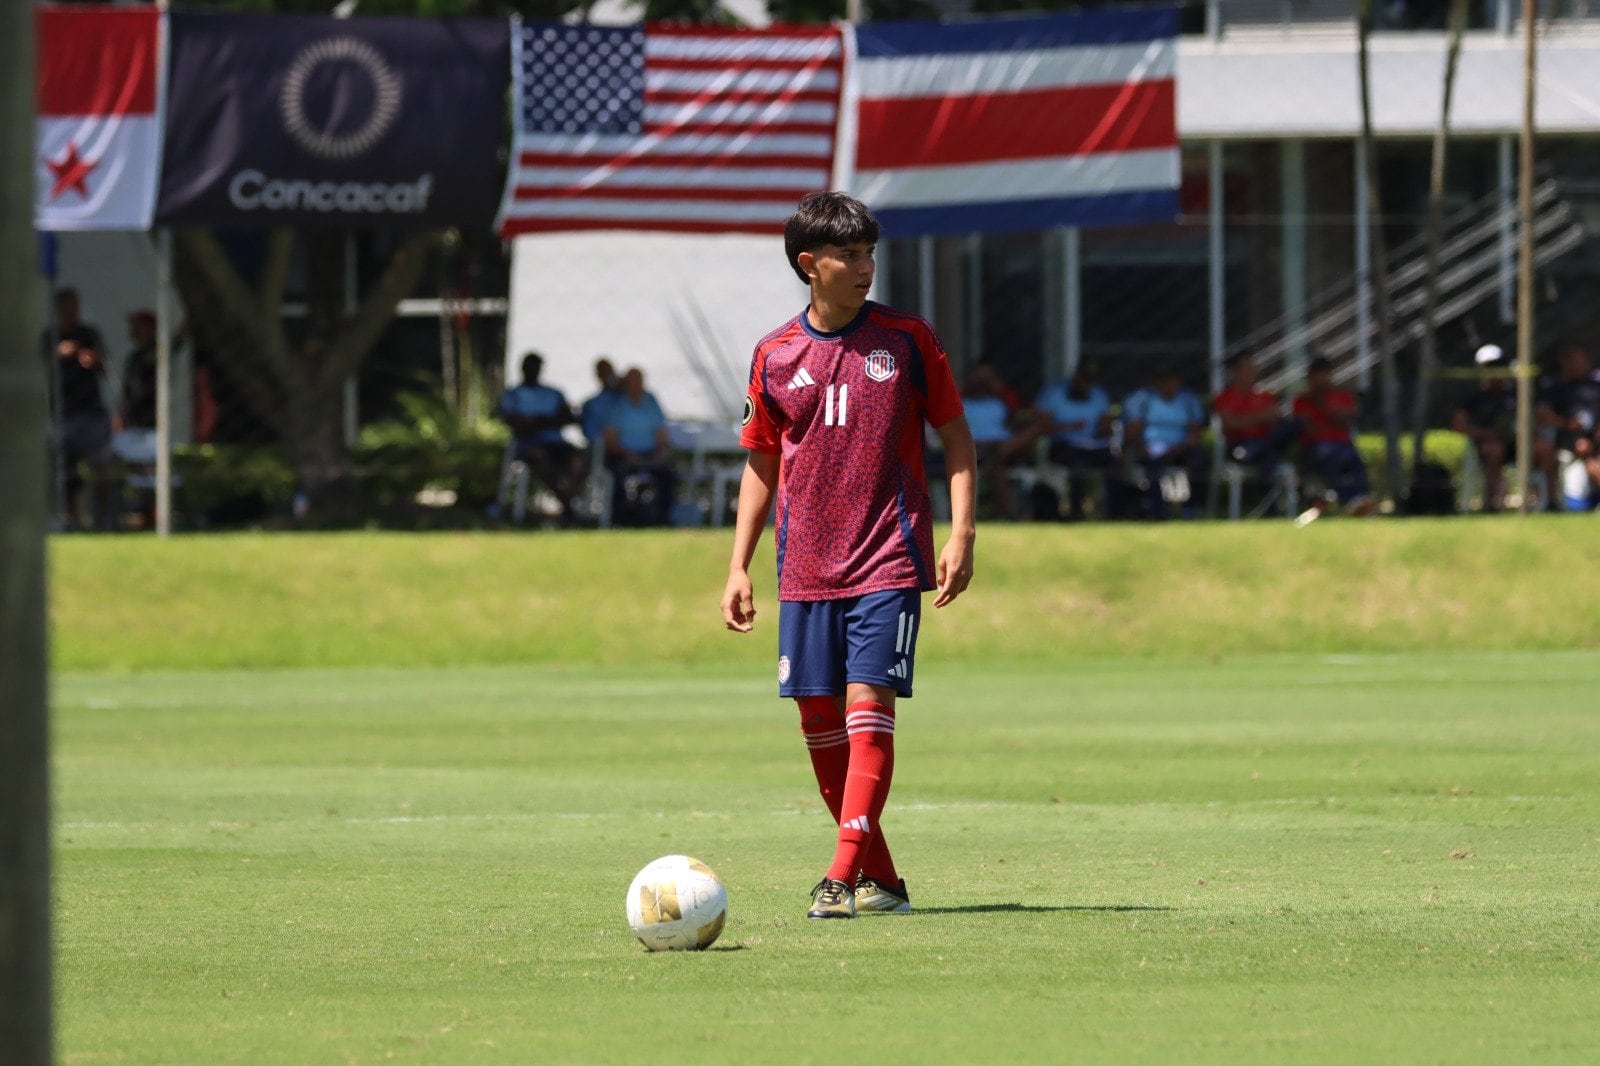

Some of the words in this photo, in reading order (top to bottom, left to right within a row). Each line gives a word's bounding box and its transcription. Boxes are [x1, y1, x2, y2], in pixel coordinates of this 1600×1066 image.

[229, 168, 433, 212] Concacaf
[872, 356, 888, 374] CR
[824, 384, 848, 426] 11
[895, 611, 914, 655] 11
